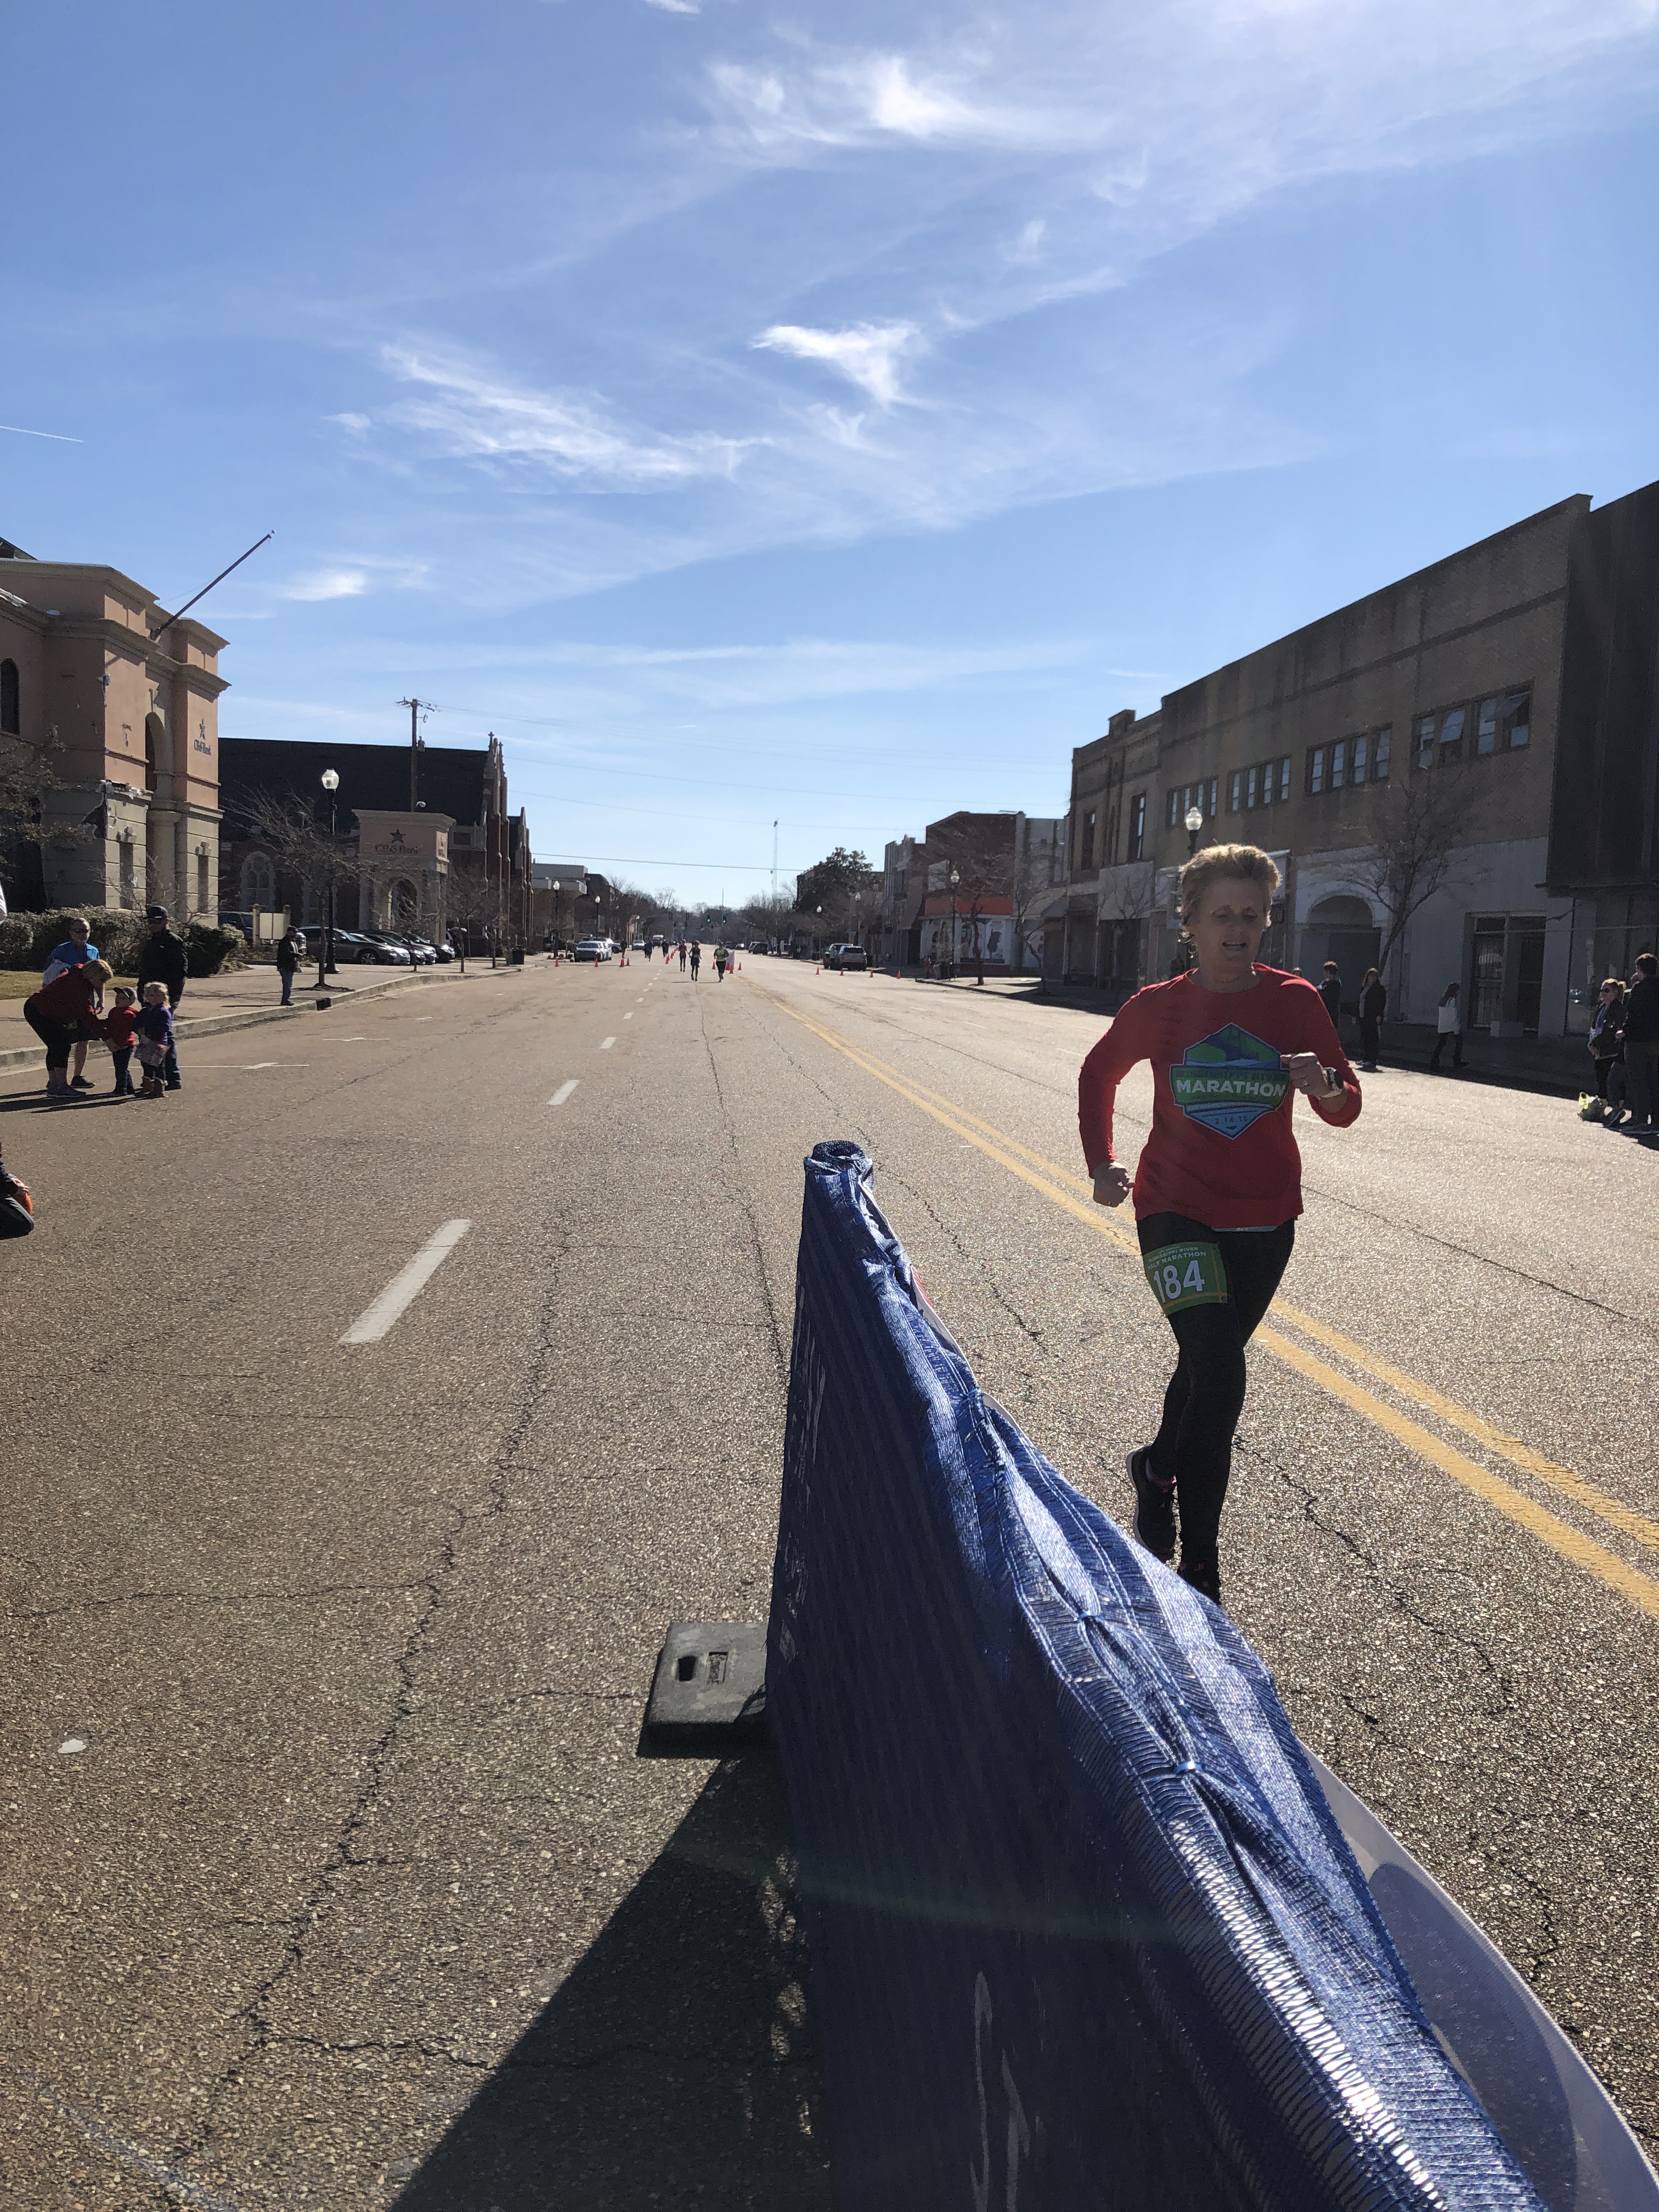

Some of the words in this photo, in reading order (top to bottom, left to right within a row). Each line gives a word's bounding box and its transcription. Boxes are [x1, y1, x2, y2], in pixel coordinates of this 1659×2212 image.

[1176, 1080, 1286, 1097] MARATHON
[1147, 1261, 1160, 1270] HALF
[1162, 1251, 1206, 1263] MARATHON
[1154, 1260, 1205, 1303] 184
